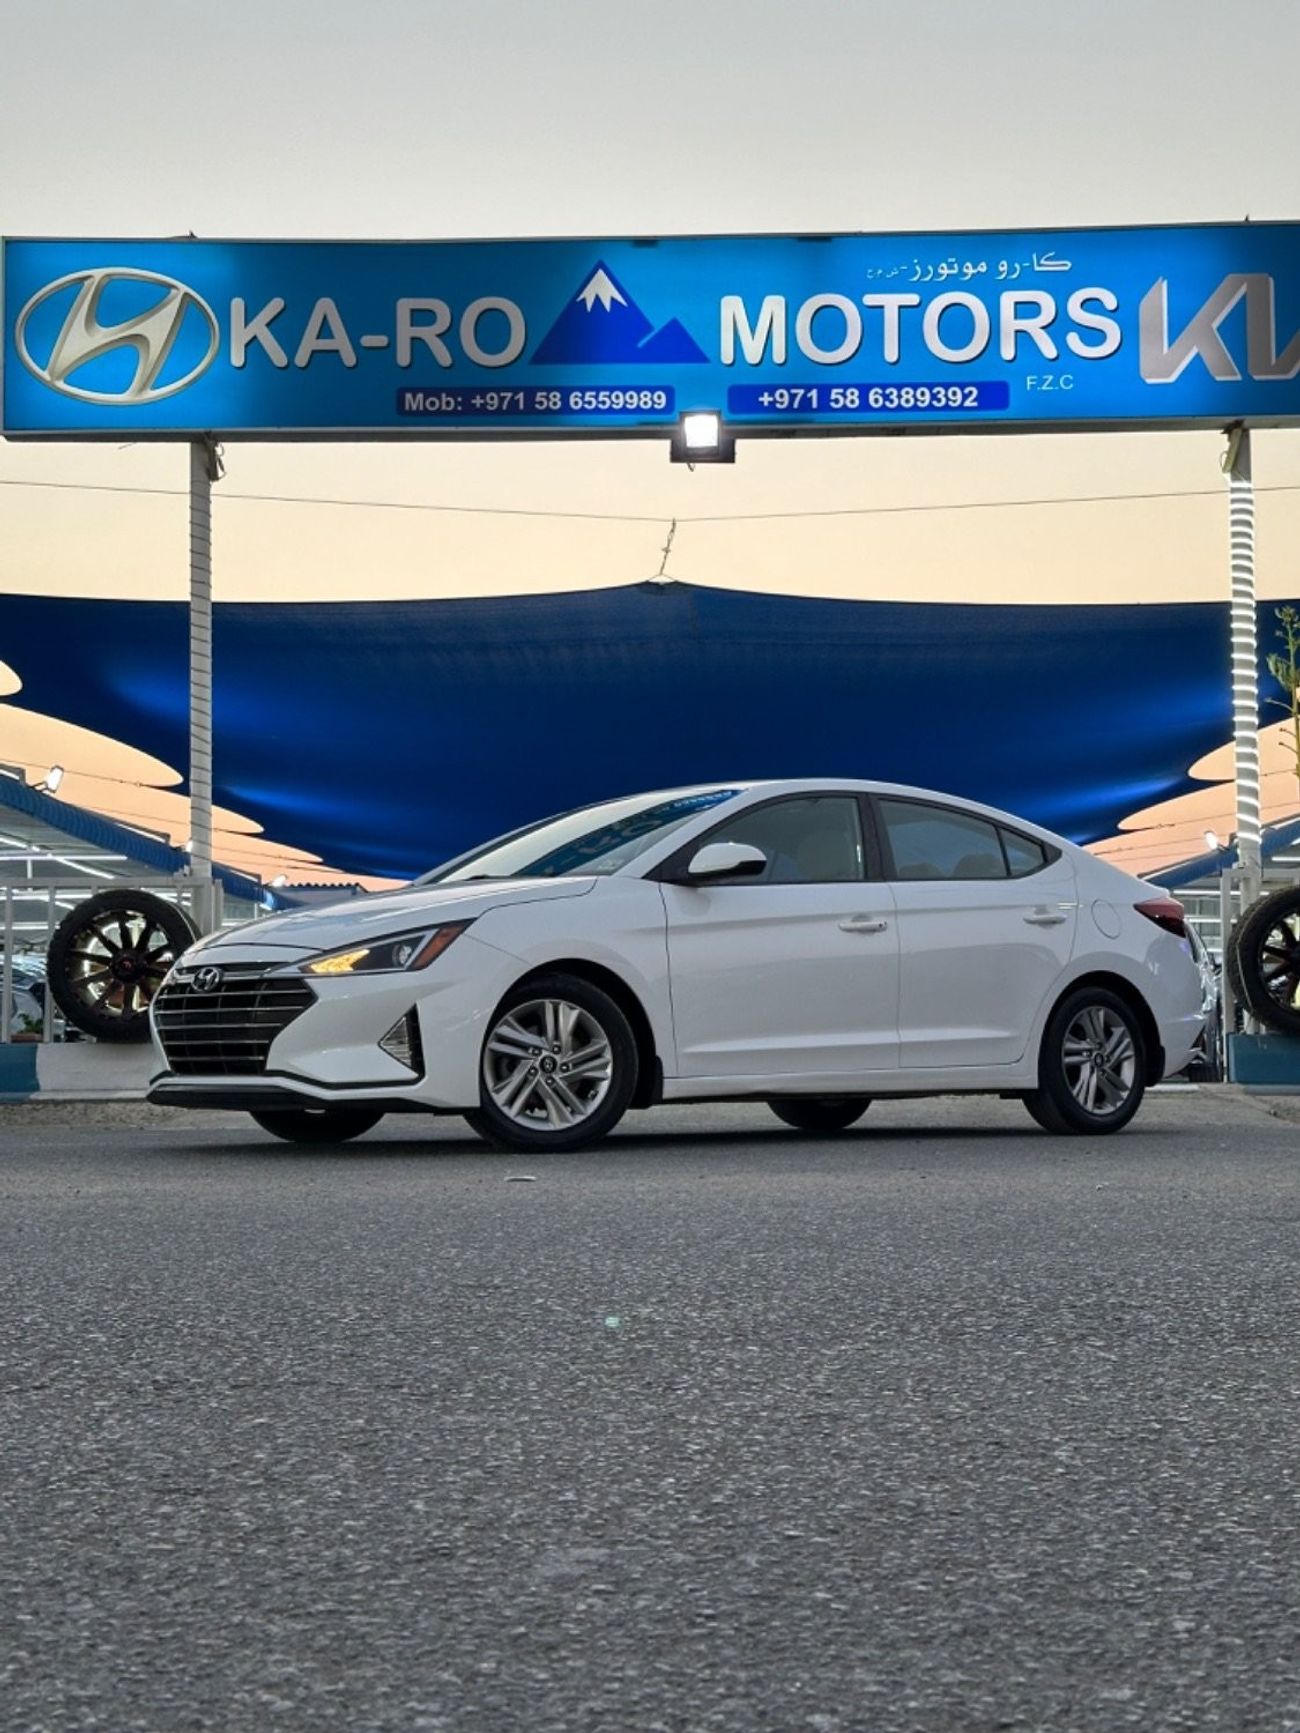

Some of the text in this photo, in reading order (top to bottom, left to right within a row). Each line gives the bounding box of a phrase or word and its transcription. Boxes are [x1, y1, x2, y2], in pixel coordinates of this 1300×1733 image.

[230, 287, 1122, 368] KA-RO MOTORS
[1026, 374, 1074, 391] F.Z.C
[404, 390, 667, 411] Mob: +971 58 6559989
[758, 386, 979, 410] +971 58 6389392
